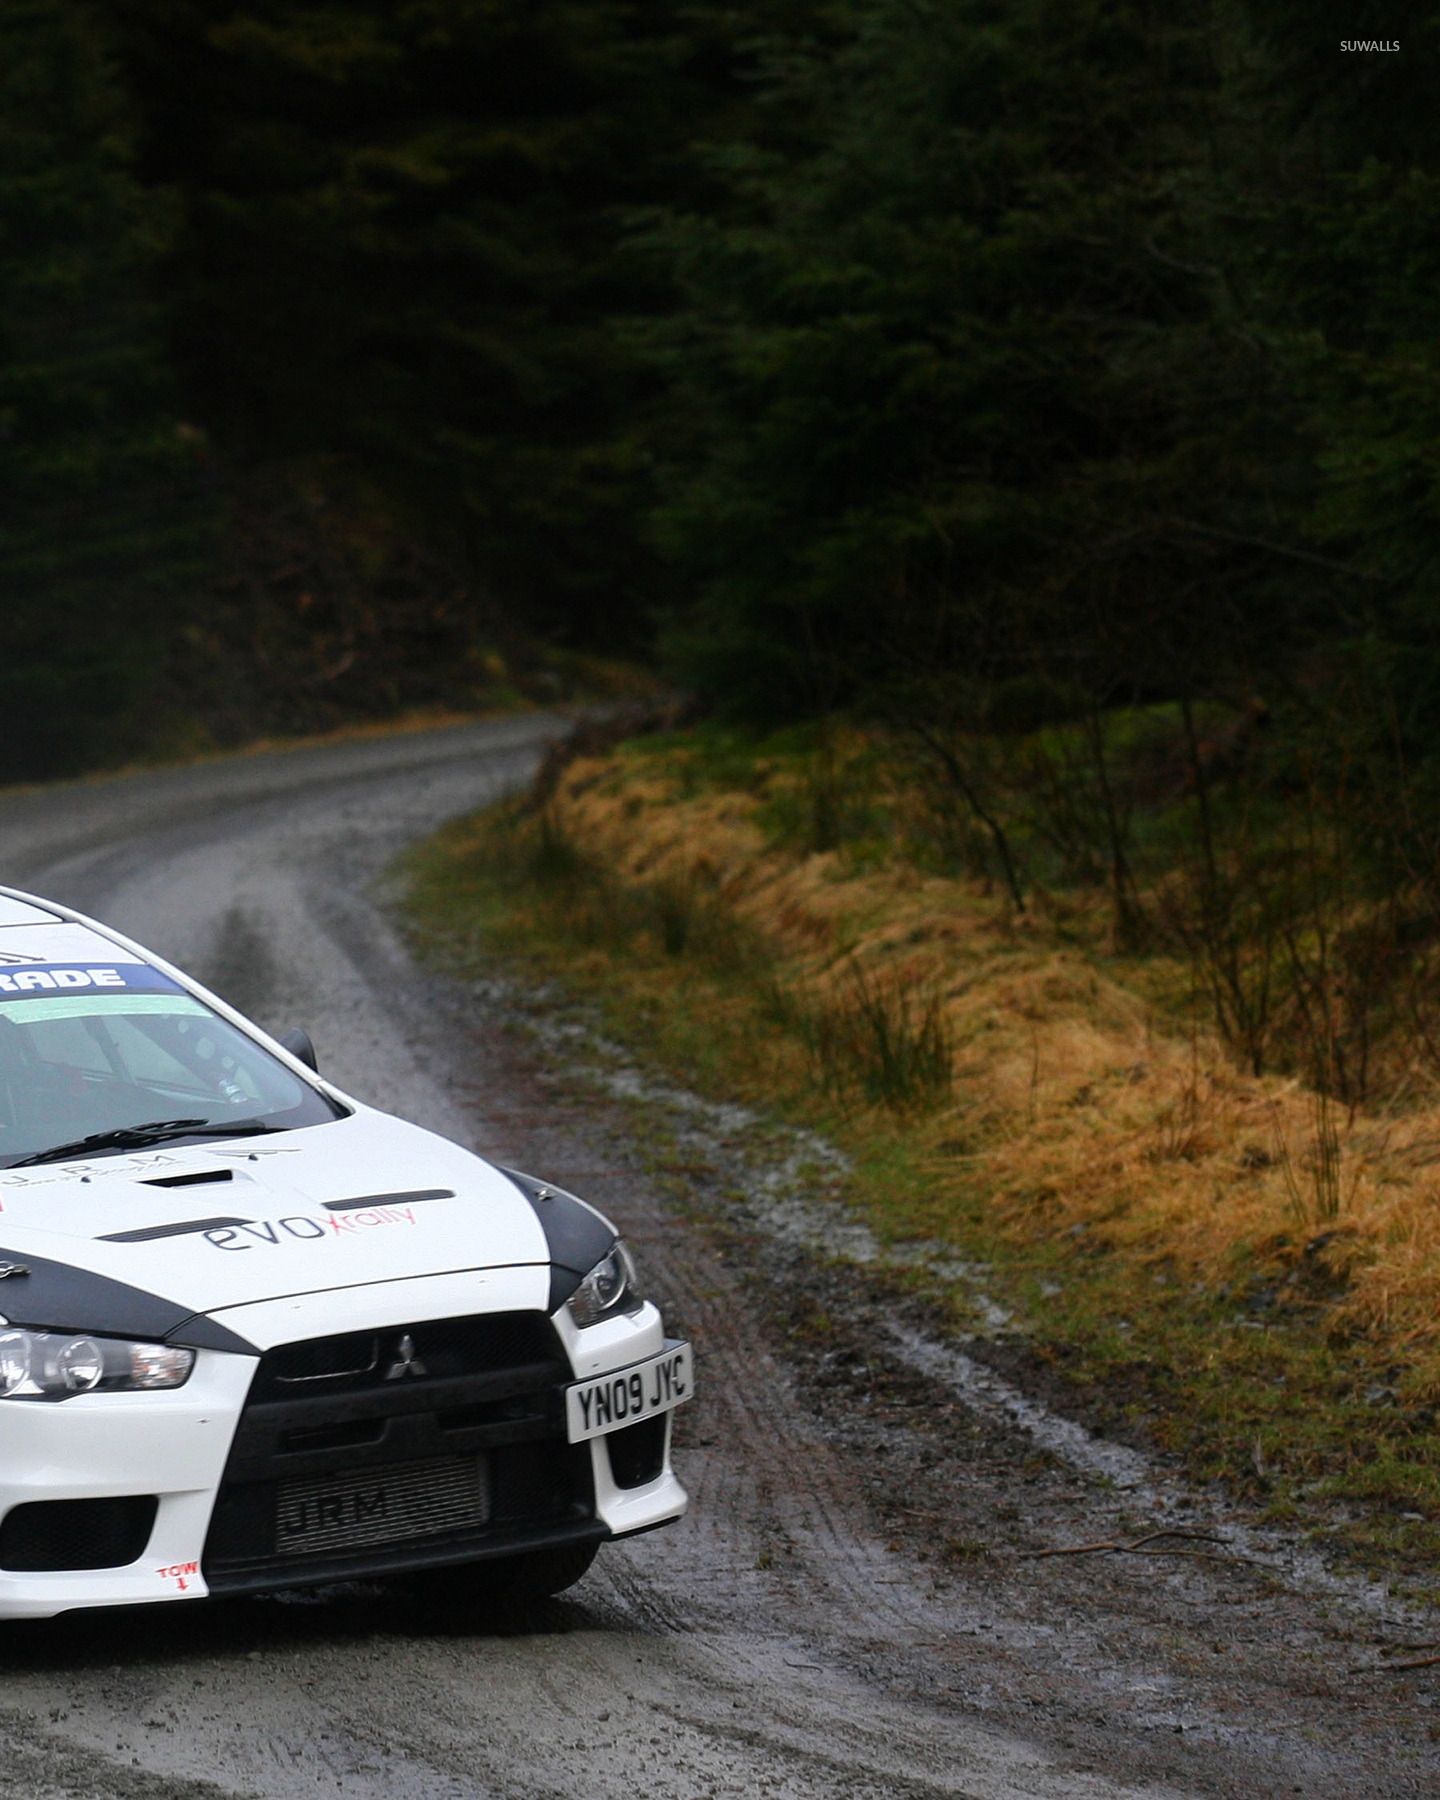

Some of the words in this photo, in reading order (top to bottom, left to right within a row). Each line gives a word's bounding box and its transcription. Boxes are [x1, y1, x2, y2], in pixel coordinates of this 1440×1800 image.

[578, 1373, 643, 1430] YN09
[650, 1354, 686, 1406] JYC
[154, 1561, 198, 1578] TOW
